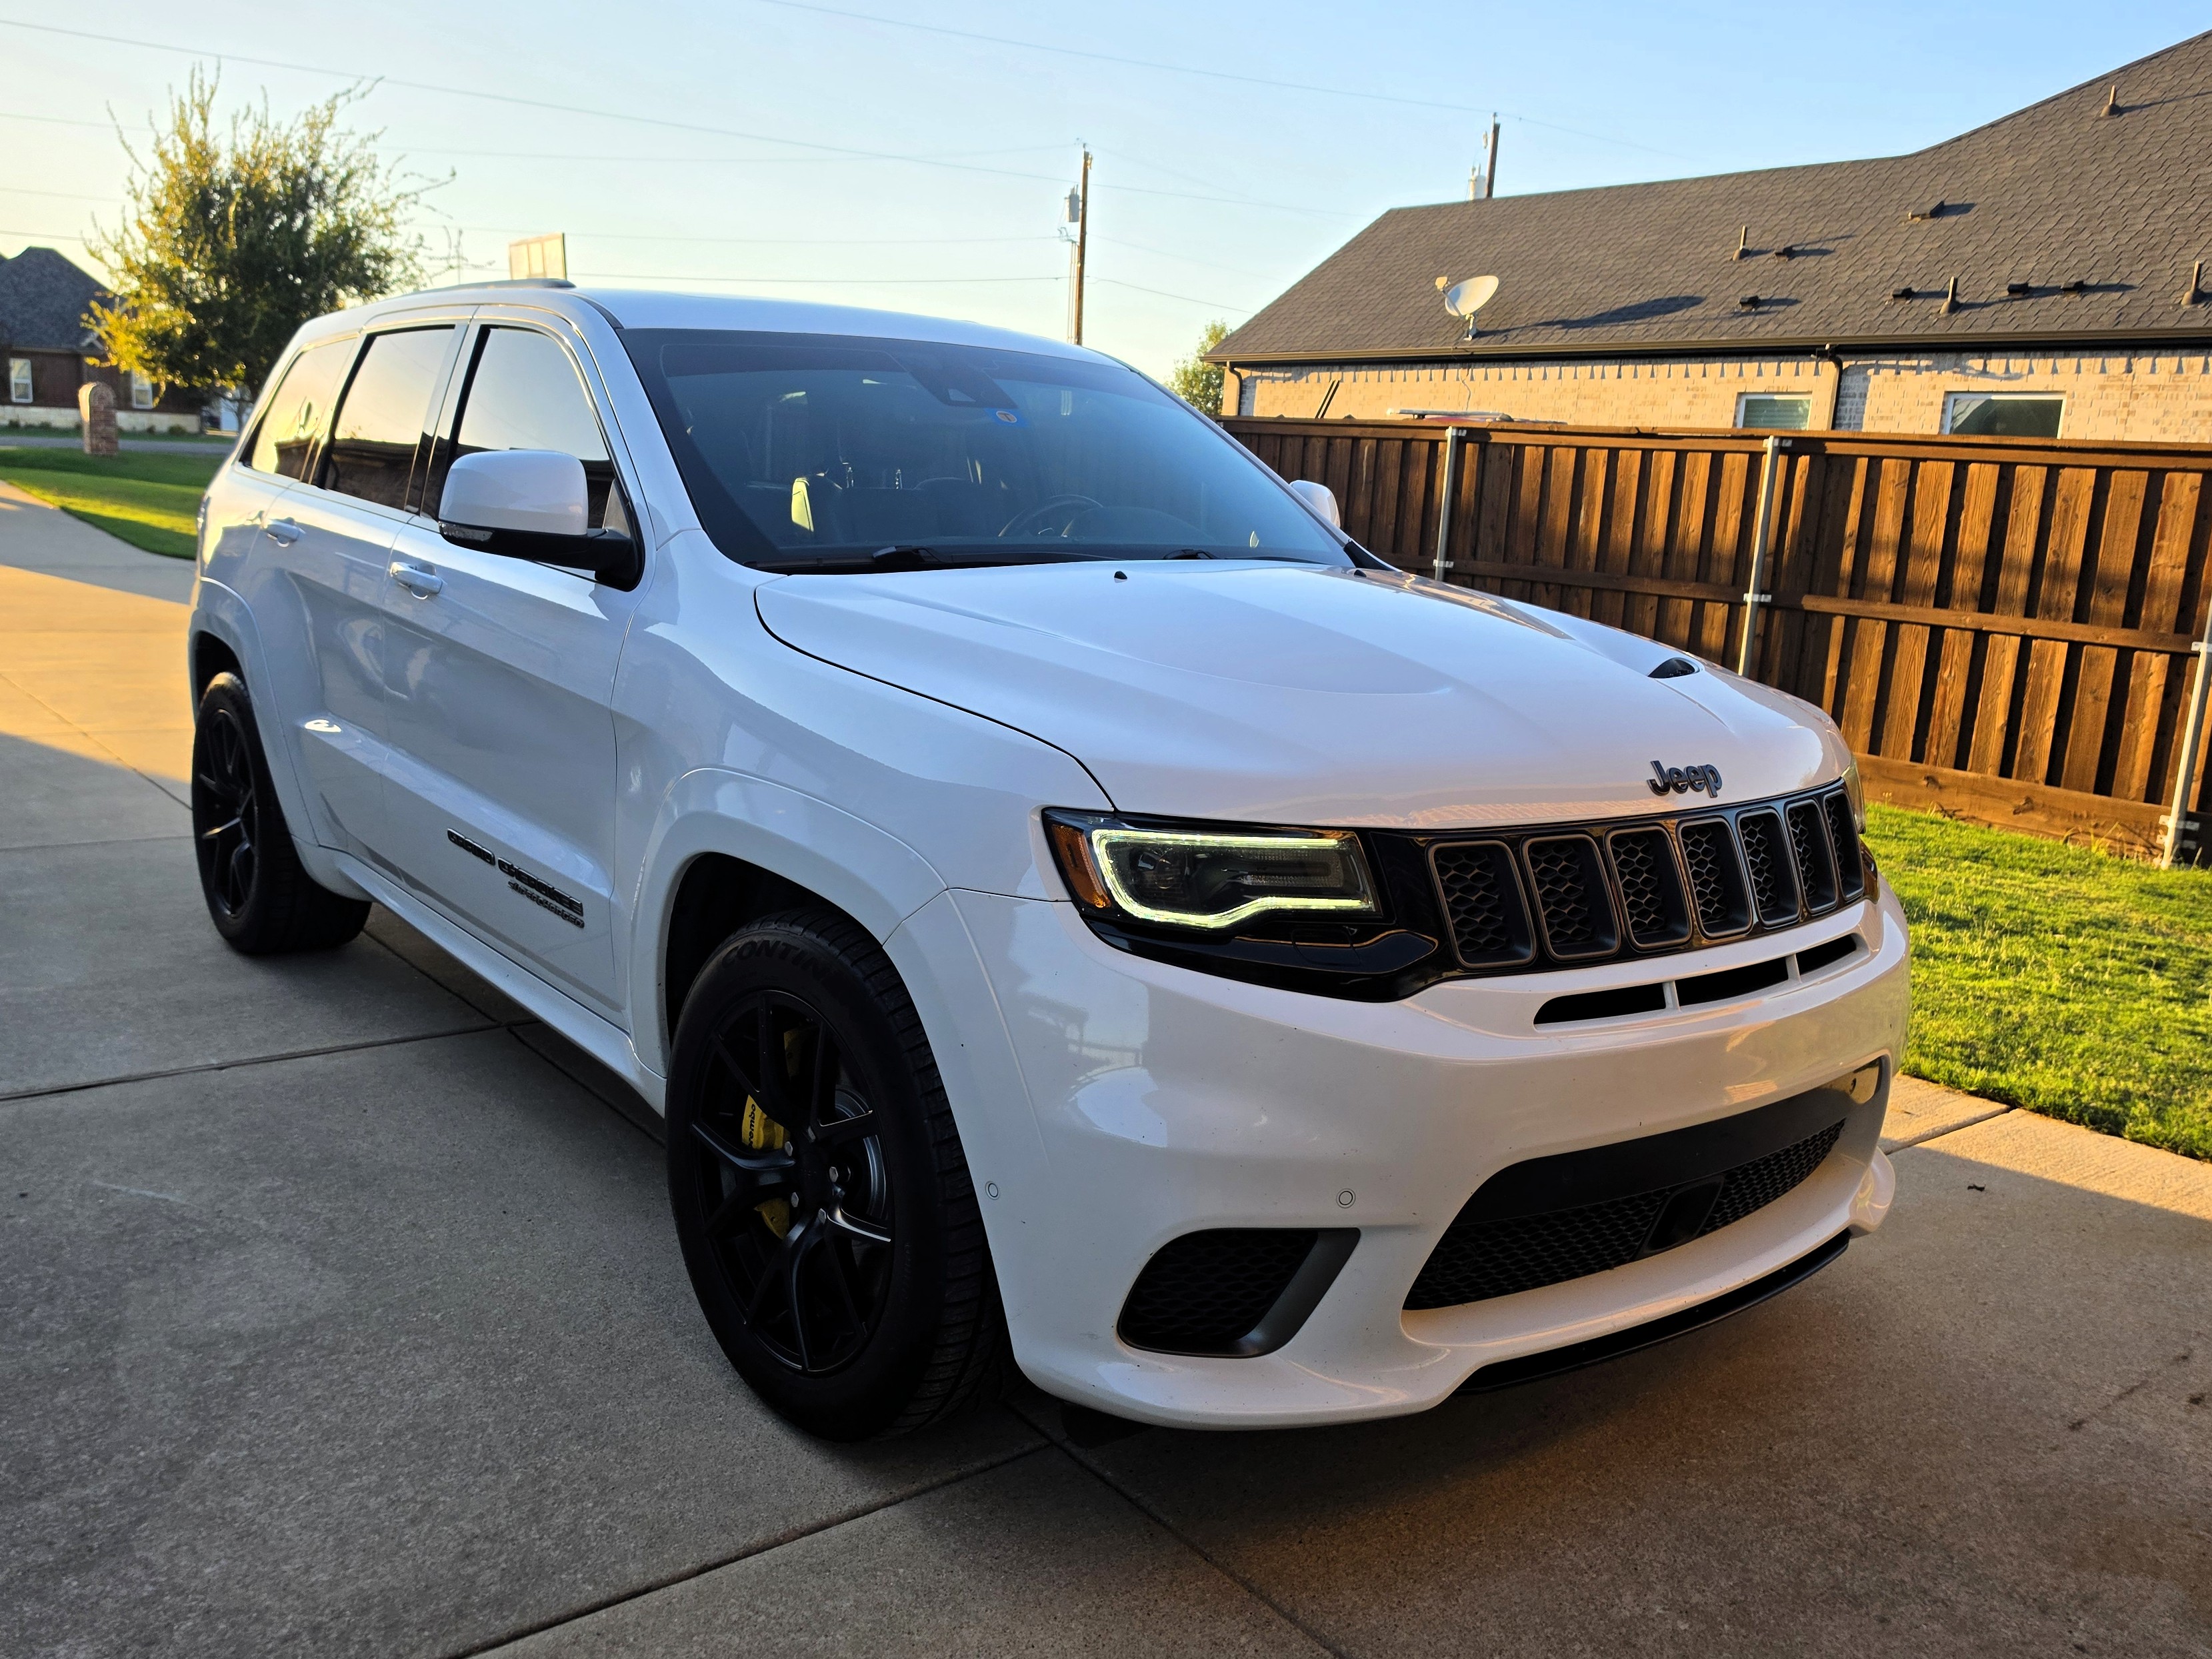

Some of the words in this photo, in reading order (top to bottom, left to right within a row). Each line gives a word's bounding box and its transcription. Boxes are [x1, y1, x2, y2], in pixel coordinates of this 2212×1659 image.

[1647, 760, 1722, 798] Jeep
[447, 828, 495, 866] GRAND
[498, 857, 583, 916] CHEROKEE
